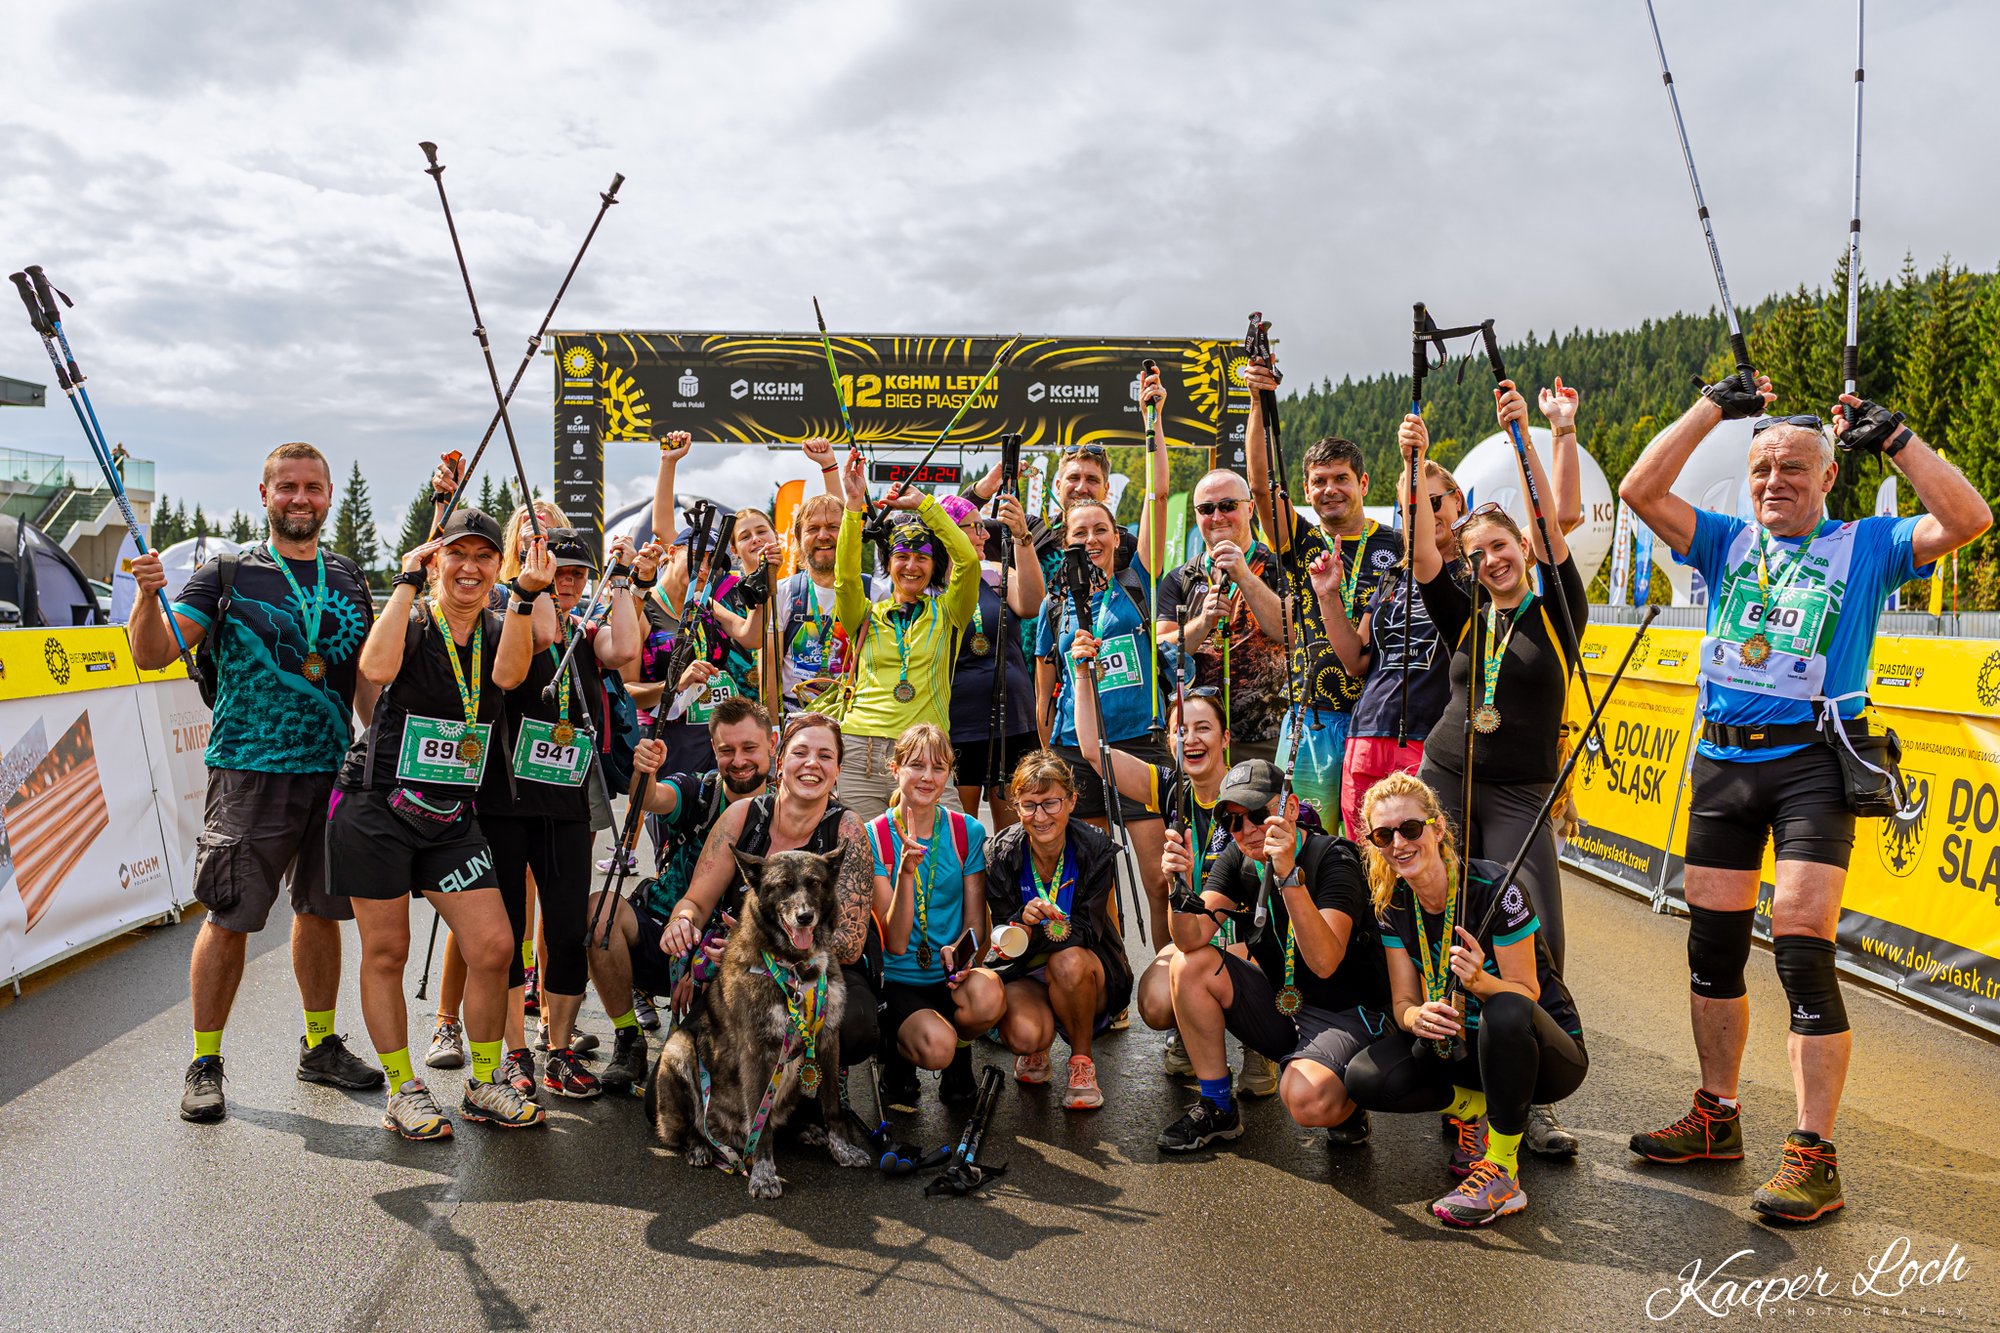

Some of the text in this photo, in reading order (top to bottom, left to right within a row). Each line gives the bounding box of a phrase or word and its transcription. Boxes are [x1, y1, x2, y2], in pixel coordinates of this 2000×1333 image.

[753, 382, 804, 395] KGHM
[836, 374, 883, 408] 12
[885, 375, 940, 390] KGHM
[1050, 385, 1100, 398] KGHM
[885, 394, 921, 409] BIEG
[1748, 604, 1799, 628] 840
[172, 728, 183, 753] Z
[424, 740, 463, 762] 89
[536, 742, 575, 763] 941
[1614, 720, 1680, 764] DOLNY
[1607, 752, 1667, 805] ŚLĄSK
[1947, 778, 2000, 834] DO
[130, 855, 160, 879] KGHM
[1861, 935, 2000, 1001] www.dolnyslask.tr
